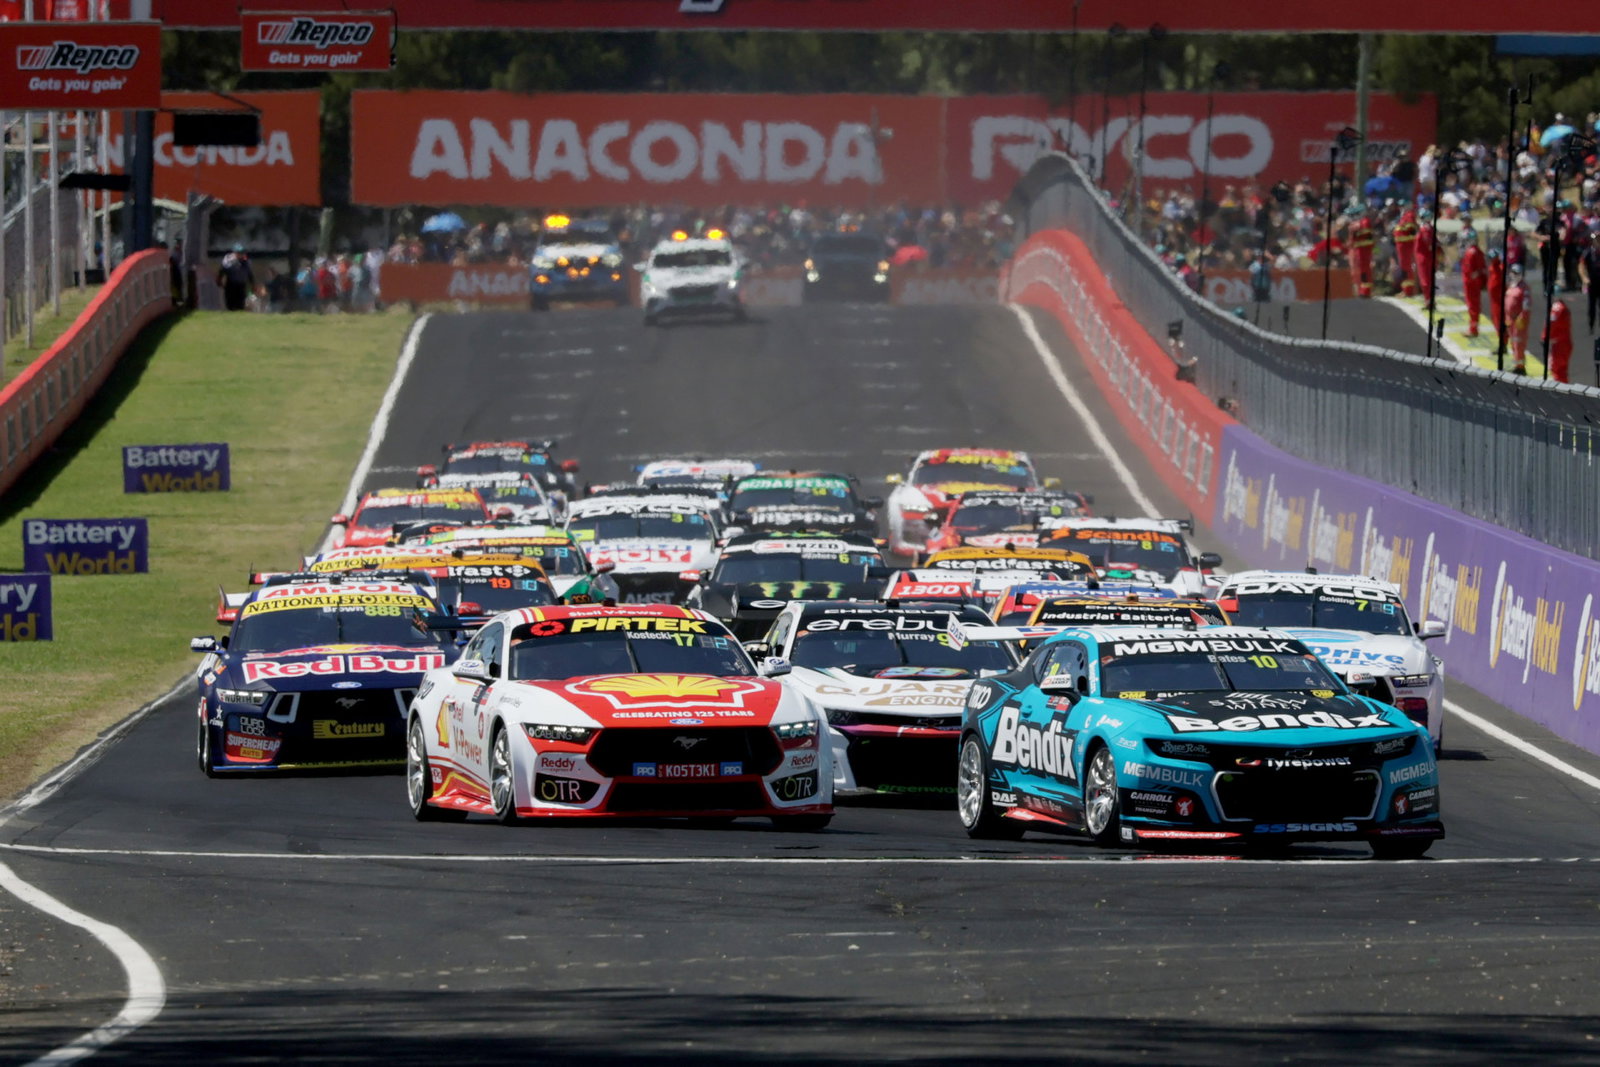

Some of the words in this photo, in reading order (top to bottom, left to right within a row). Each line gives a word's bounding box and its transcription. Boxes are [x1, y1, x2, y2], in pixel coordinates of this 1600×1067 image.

[290, 17, 374, 48] Repco
[48, 42, 139, 74] Repco
[269, 51, 299, 64] Gets
[303, 54, 328, 67] you
[29, 77, 60, 91] Gets
[64, 79, 90, 93] you
[410, 117, 884, 184] ANACONDA
[126, 447, 220, 470] Battery
[142, 470, 220, 492] World
[26, 520, 136, 550] Battery
[44, 550, 136, 575] World
[588, 549, 690, 565] MOLY
[838, 553, 850, 564] 6
[488, 577, 512, 589] 19
[897, 584, 961, 597] 1300
[1235, 581, 1388, 602] DAYCO
[247, 594, 338, 614] NATIONAL
[342, 594, 430, 608] STORAGE
[323, 604, 365, 614] Brown
[364, 605, 402, 617] 888
[824, 607, 964, 616] CHEVROLET
[1354, 599, 1369, 612] 7
[570, 616, 708, 634] PIRTEK
[1041, 612, 1116, 623] Industrial
[1120, 613, 1193, 624] Batteries
[626, 631, 673, 640] Kostecki
[671, 632, 695, 647] 17
[887, 631, 936, 642] Murray
[241, 655, 346, 684] Red
[348, 654, 446, 674] Bull
[1207, 654, 1247, 664] Bates
[1247, 654, 1279, 669] 10
[327, 720, 384, 736] Century
[1166, 711, 1390, 733] Bendix
[227, 734, 280, 752] SUPERCHEAP
[991, 705, 1077, 780] Bendix
[541, 757, 576, 772] Reddy
[790, 755, 816, 770] Reddy
[1266, 756, 1352, 771] Tyrepower
[540, 779, 582, 801] OTR
[784, 776, 813, 798] OTR
[991, 791, 1018, 803] DAF
[1129, 791, 1174, 803] CARROLL
